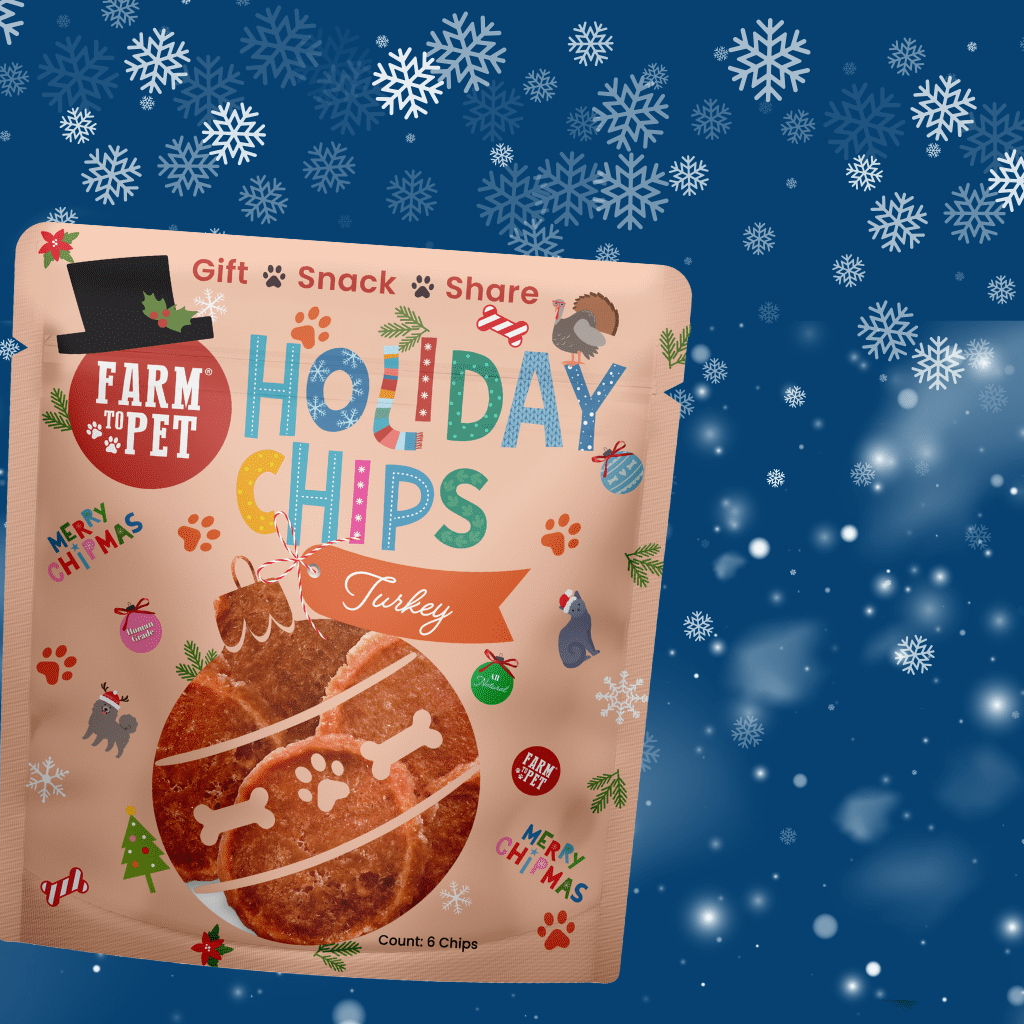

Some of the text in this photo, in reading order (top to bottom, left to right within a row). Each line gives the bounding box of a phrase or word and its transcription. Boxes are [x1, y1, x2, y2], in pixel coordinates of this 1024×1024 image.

[192, 258, 539, 305] Gift Snack Share
[244, 334, 626, 451] HOLIDAY
[104, 410, 197, 459] TO PET
[235, 441, 489, 551] CHIPS
[47, 501, 107, 553] MERRY
[342, 571, 453, 636] Turkey
[126, 621, 154, 636] Human
[522, 752, 556, 778] FARM
[523, 771, 547, 790] PET
[521, 823, 585, 869] MERRY
[378, 934, 478, 952] Count: 6 Chips
